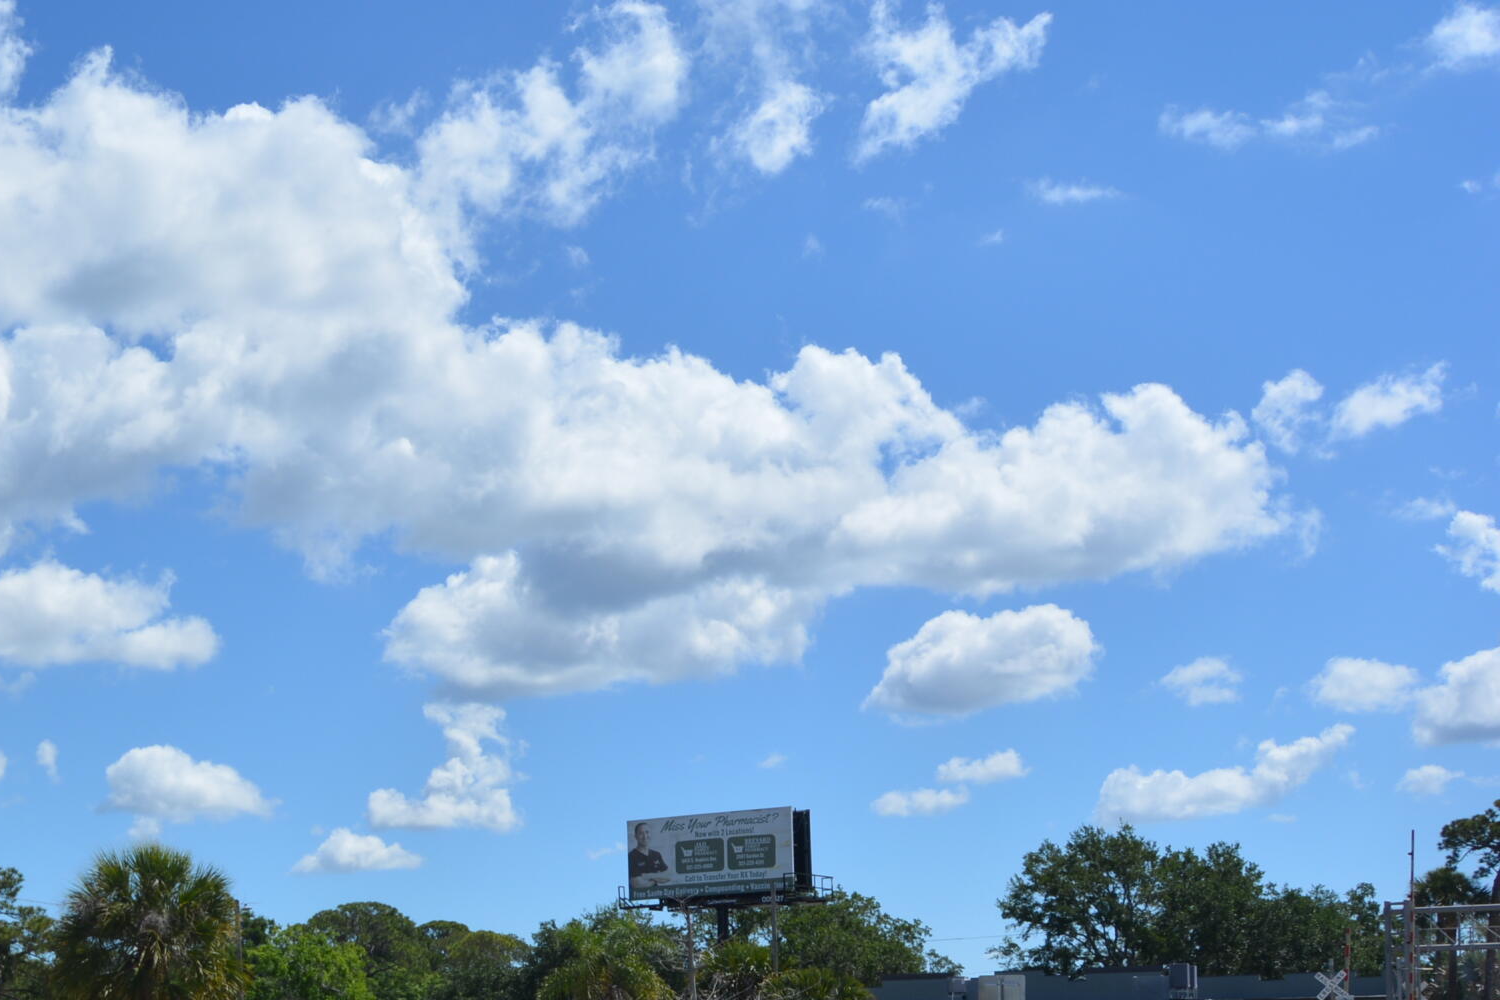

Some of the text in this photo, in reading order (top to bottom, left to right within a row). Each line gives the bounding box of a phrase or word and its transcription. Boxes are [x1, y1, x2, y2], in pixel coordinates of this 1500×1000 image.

[660, 819, 685, 833] Miss
[687, 818, 712, 833] Your
[708, 829, 720, 837] with
[702, 872, 726, 881] Transfer
